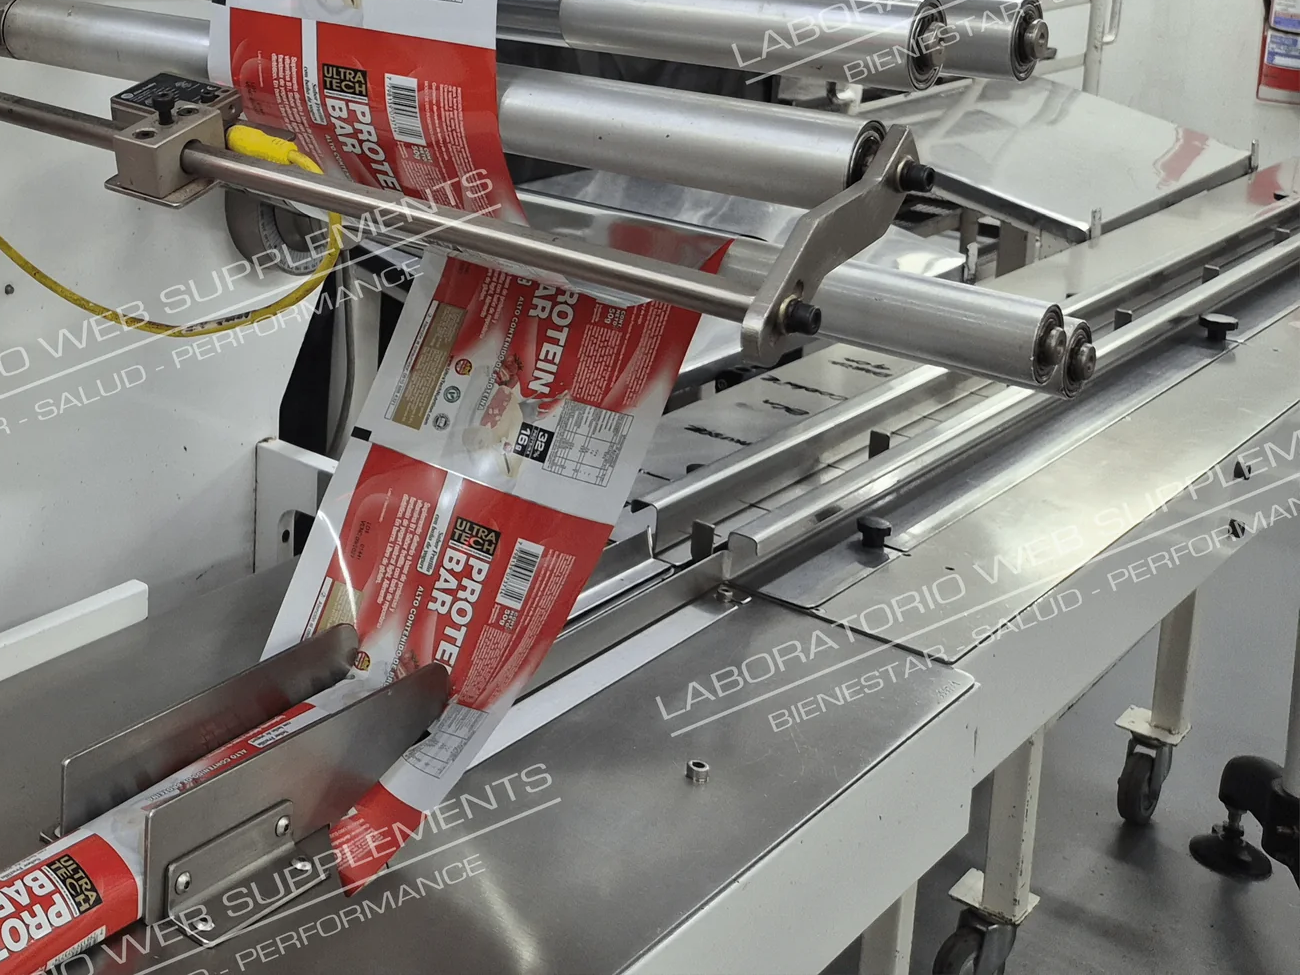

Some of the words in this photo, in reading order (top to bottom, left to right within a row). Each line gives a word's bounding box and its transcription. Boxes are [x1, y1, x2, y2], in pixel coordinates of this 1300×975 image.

[323, 80, 368, 96] TECH
[324, 66, 366, 84] ULTRA
[326, 98, 363, 154] BAR
[349, 107, 401, 193] PROTE
[513, 296, 524, 315] ALTO
[527, 281, 556, 321] AR
[496, 315, 518, 362] CONTENIDO
[526, 287, 580, 396] ROTEIN
[531, 431, 548, 459] 32%
[450, 529, 495, 553] TECH
[454, 518, 499, 542] ULTRA
[411, 585, 424, 607] ALTO
[426, 547, 467, 616] BAR
[394, 607, 416, 656] CONTENIDO
[390, 658, 399, 670] DE
[49, 861, 89, 914] TECH
[59, 854, 99, 907] ULTRA
